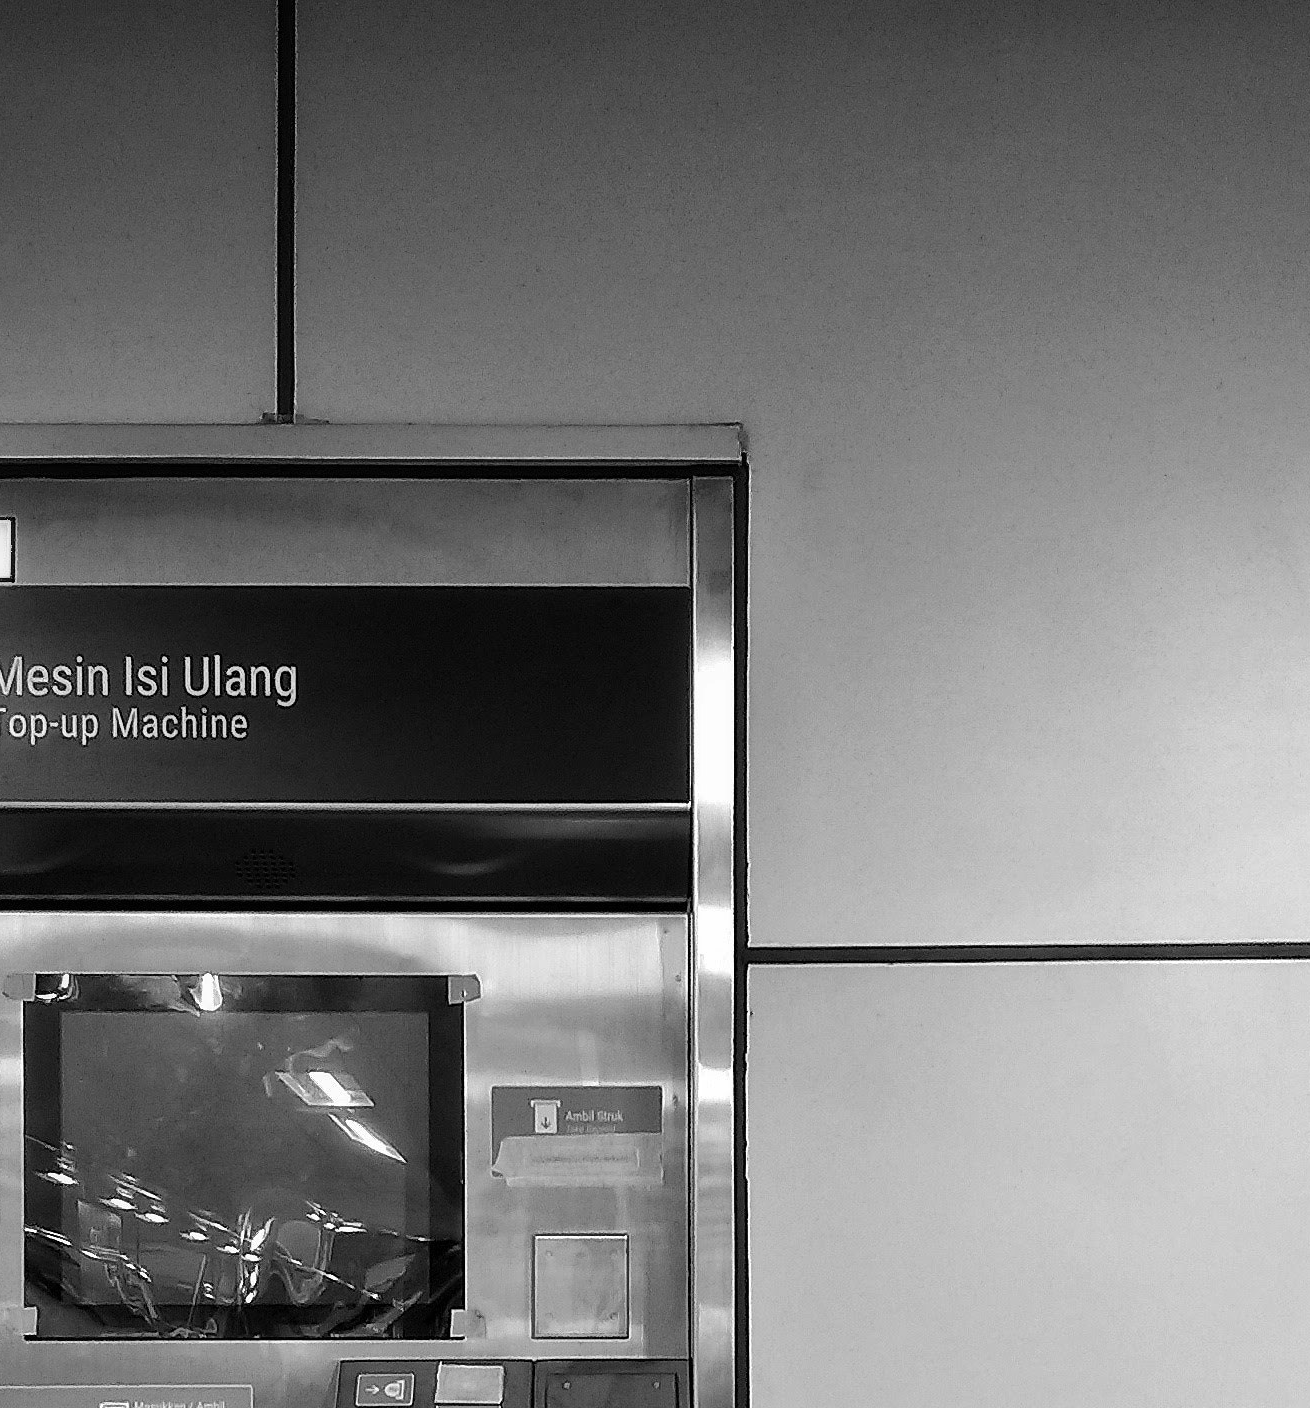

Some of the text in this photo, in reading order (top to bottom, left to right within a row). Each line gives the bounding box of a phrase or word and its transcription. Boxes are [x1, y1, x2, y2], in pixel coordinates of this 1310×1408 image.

[122, 657, 169, 697] Isi
[183, 656, 299, 706] Ulang
[112, 707, 249, 740] Machine
[565, 1110, 595, 1122] Ambil
